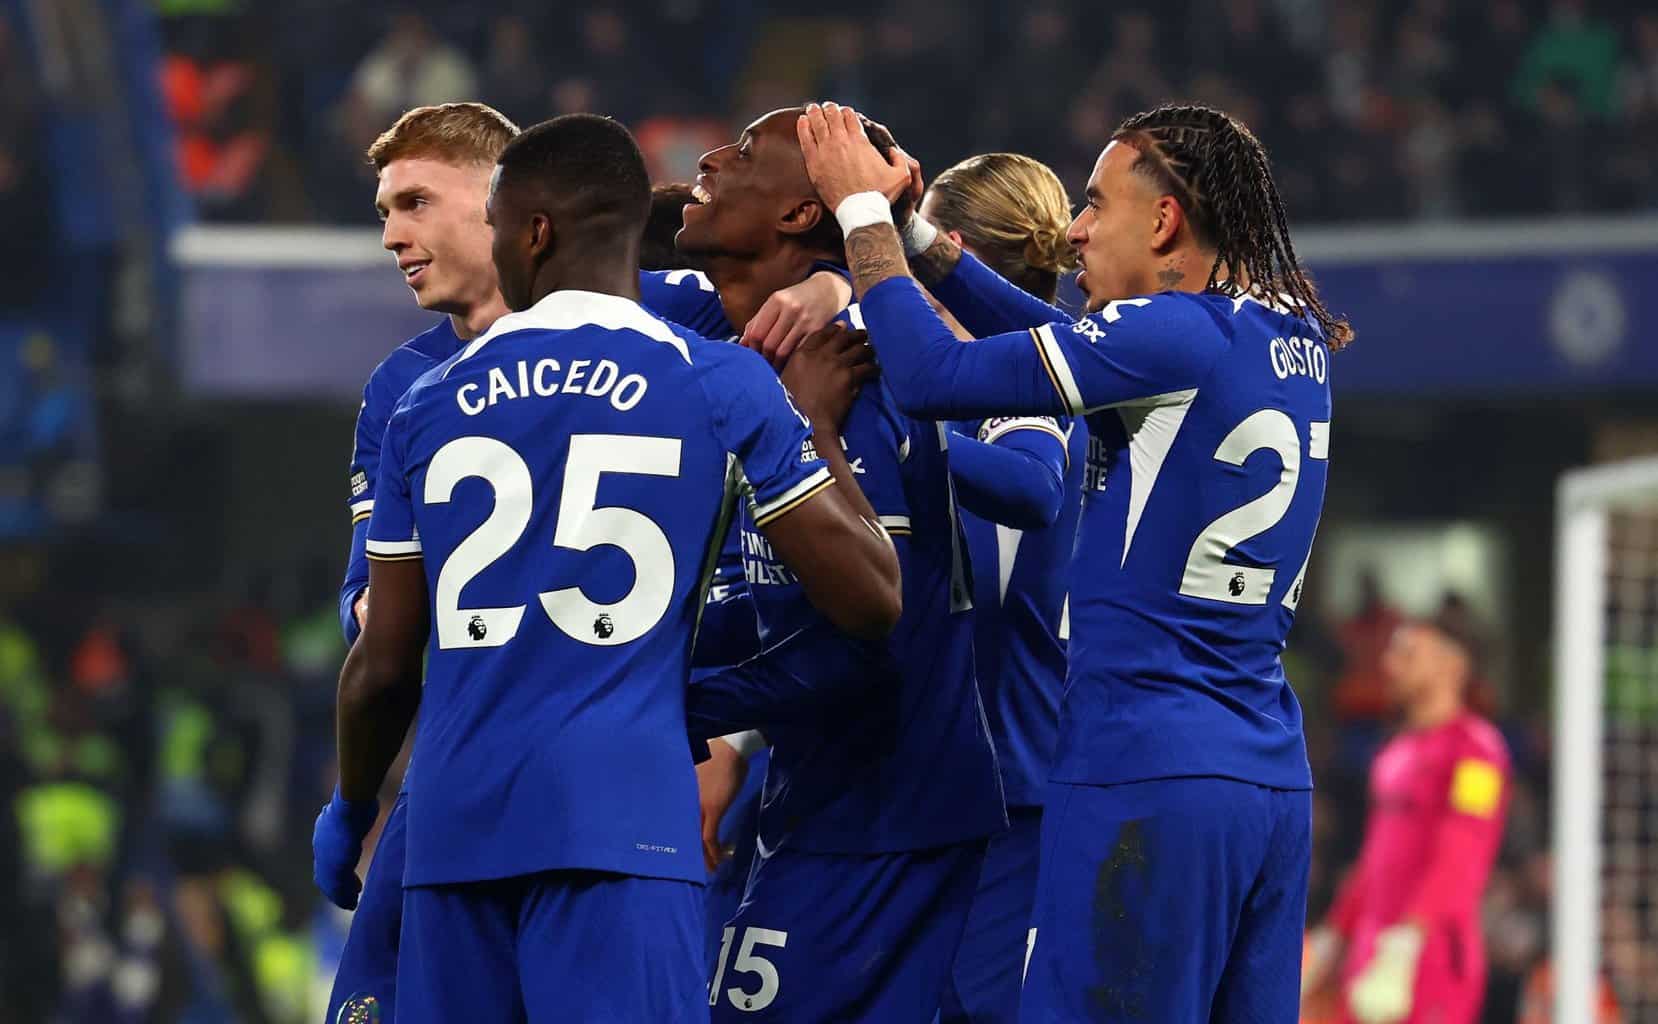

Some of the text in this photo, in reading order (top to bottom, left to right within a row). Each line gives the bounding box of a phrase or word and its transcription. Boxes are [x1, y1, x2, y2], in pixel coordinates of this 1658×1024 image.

[456, 358, 648, 416] CAICEDO
[1270, 336, 1326, 384] GUSTO
[424, 434, 682, 650] 25
[709, 926, 788, 1012] 15
